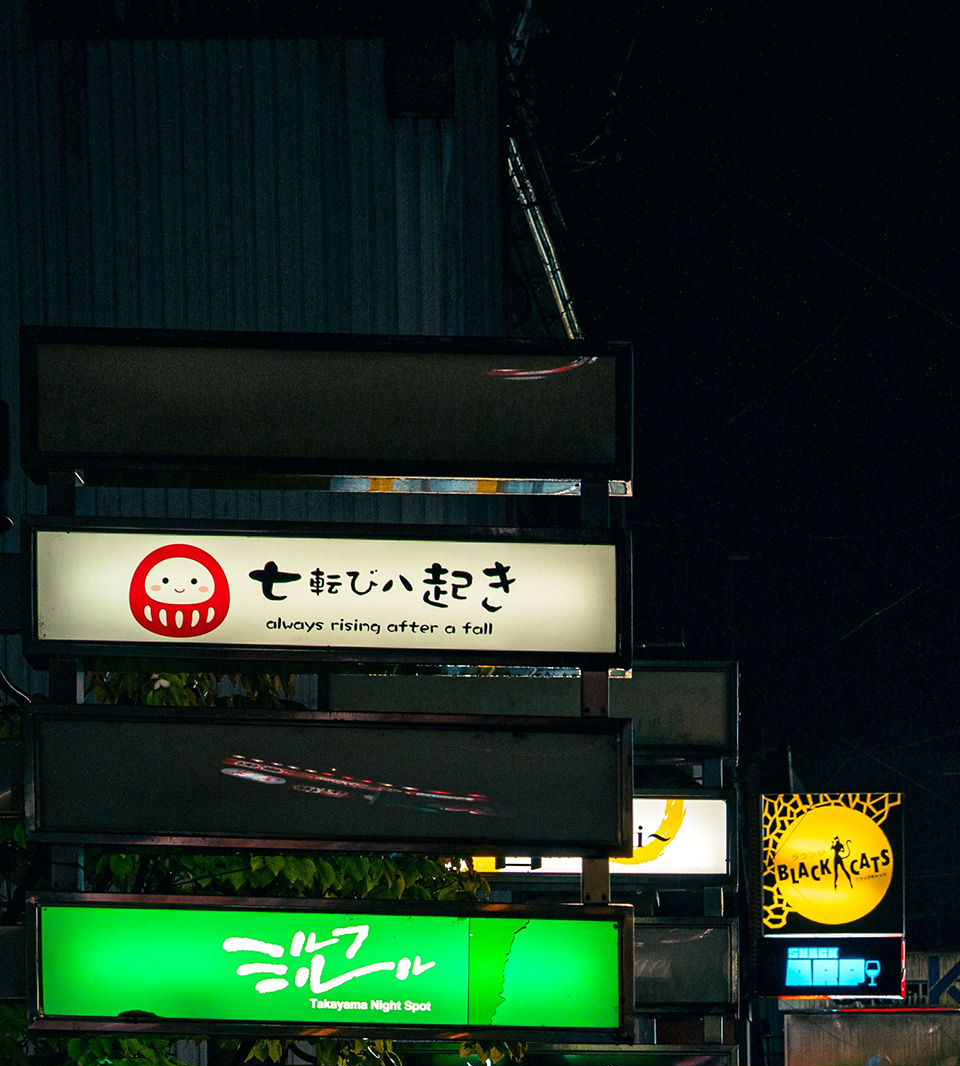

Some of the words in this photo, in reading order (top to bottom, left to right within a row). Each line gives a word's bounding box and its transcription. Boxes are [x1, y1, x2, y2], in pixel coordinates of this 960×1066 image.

[248, 560, 516, 613] 七転び八起き
[266, 617, 324, 632] always
[331, 618, 381, 635] rising
[387, 620, 439, 634] after
[444, 624, 456, 635] a
[462, 622, 493, 636] fall
[777, 858, 832, 884] BLACK
[850, 849, 890, 876] CATS
[309, 998, 368, 1010] Takayama
[370, 999, 402, 1012] Night
[404, 1001, 432, 1012] Spot
